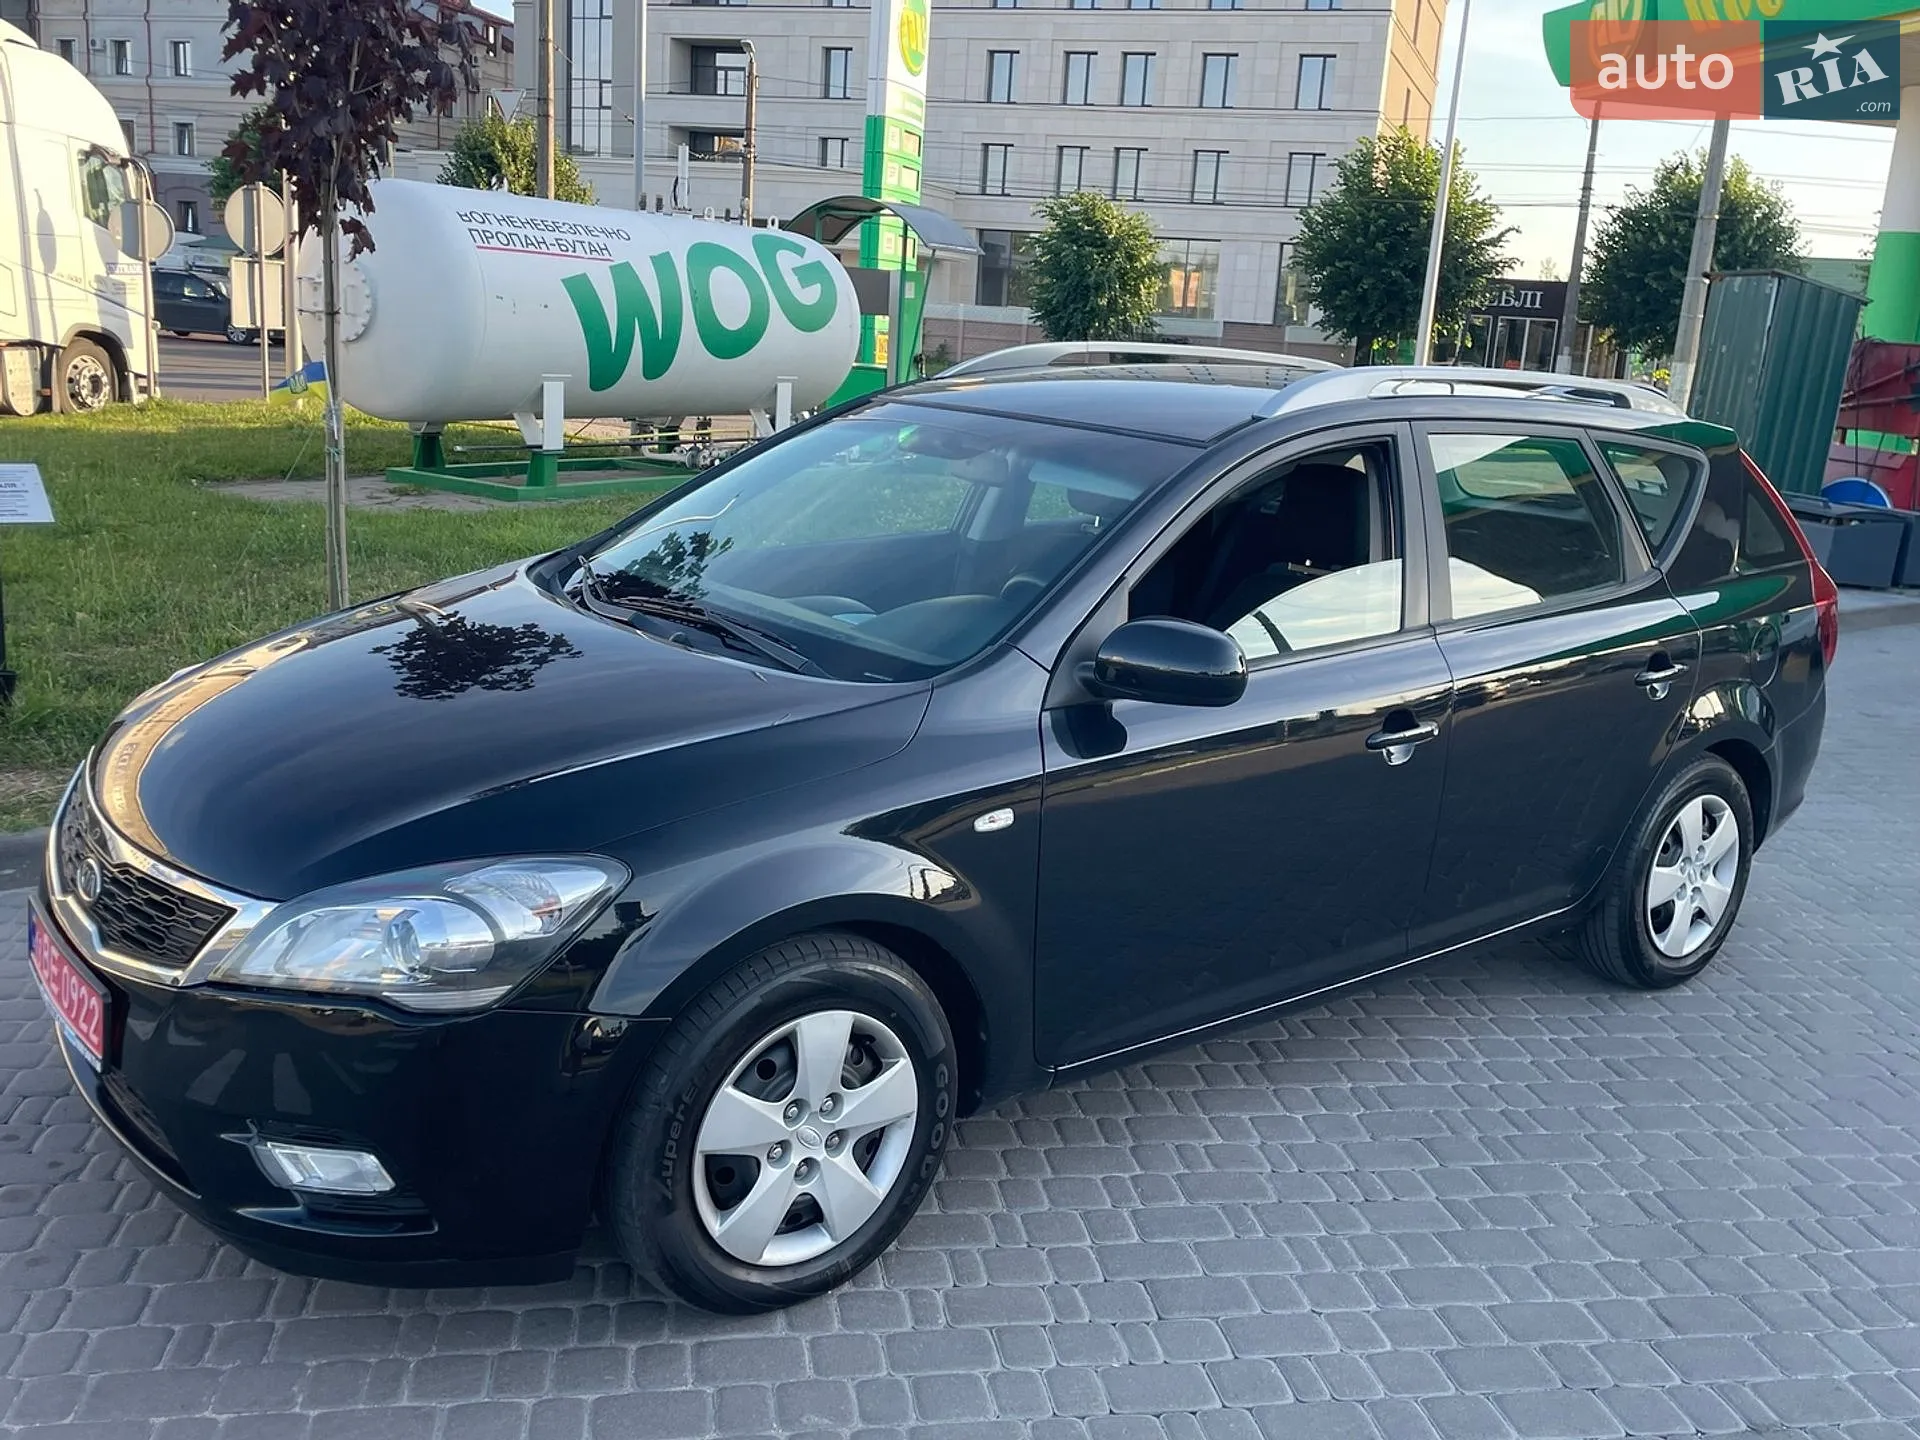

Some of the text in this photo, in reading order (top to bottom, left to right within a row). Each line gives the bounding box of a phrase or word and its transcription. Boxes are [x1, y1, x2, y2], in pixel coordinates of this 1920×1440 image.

[468, 228, 613, 257] ПРОПАН-БУТАН
[561, 233, 838, 393] WOG
[61, 965, 100, 1045] 0922
